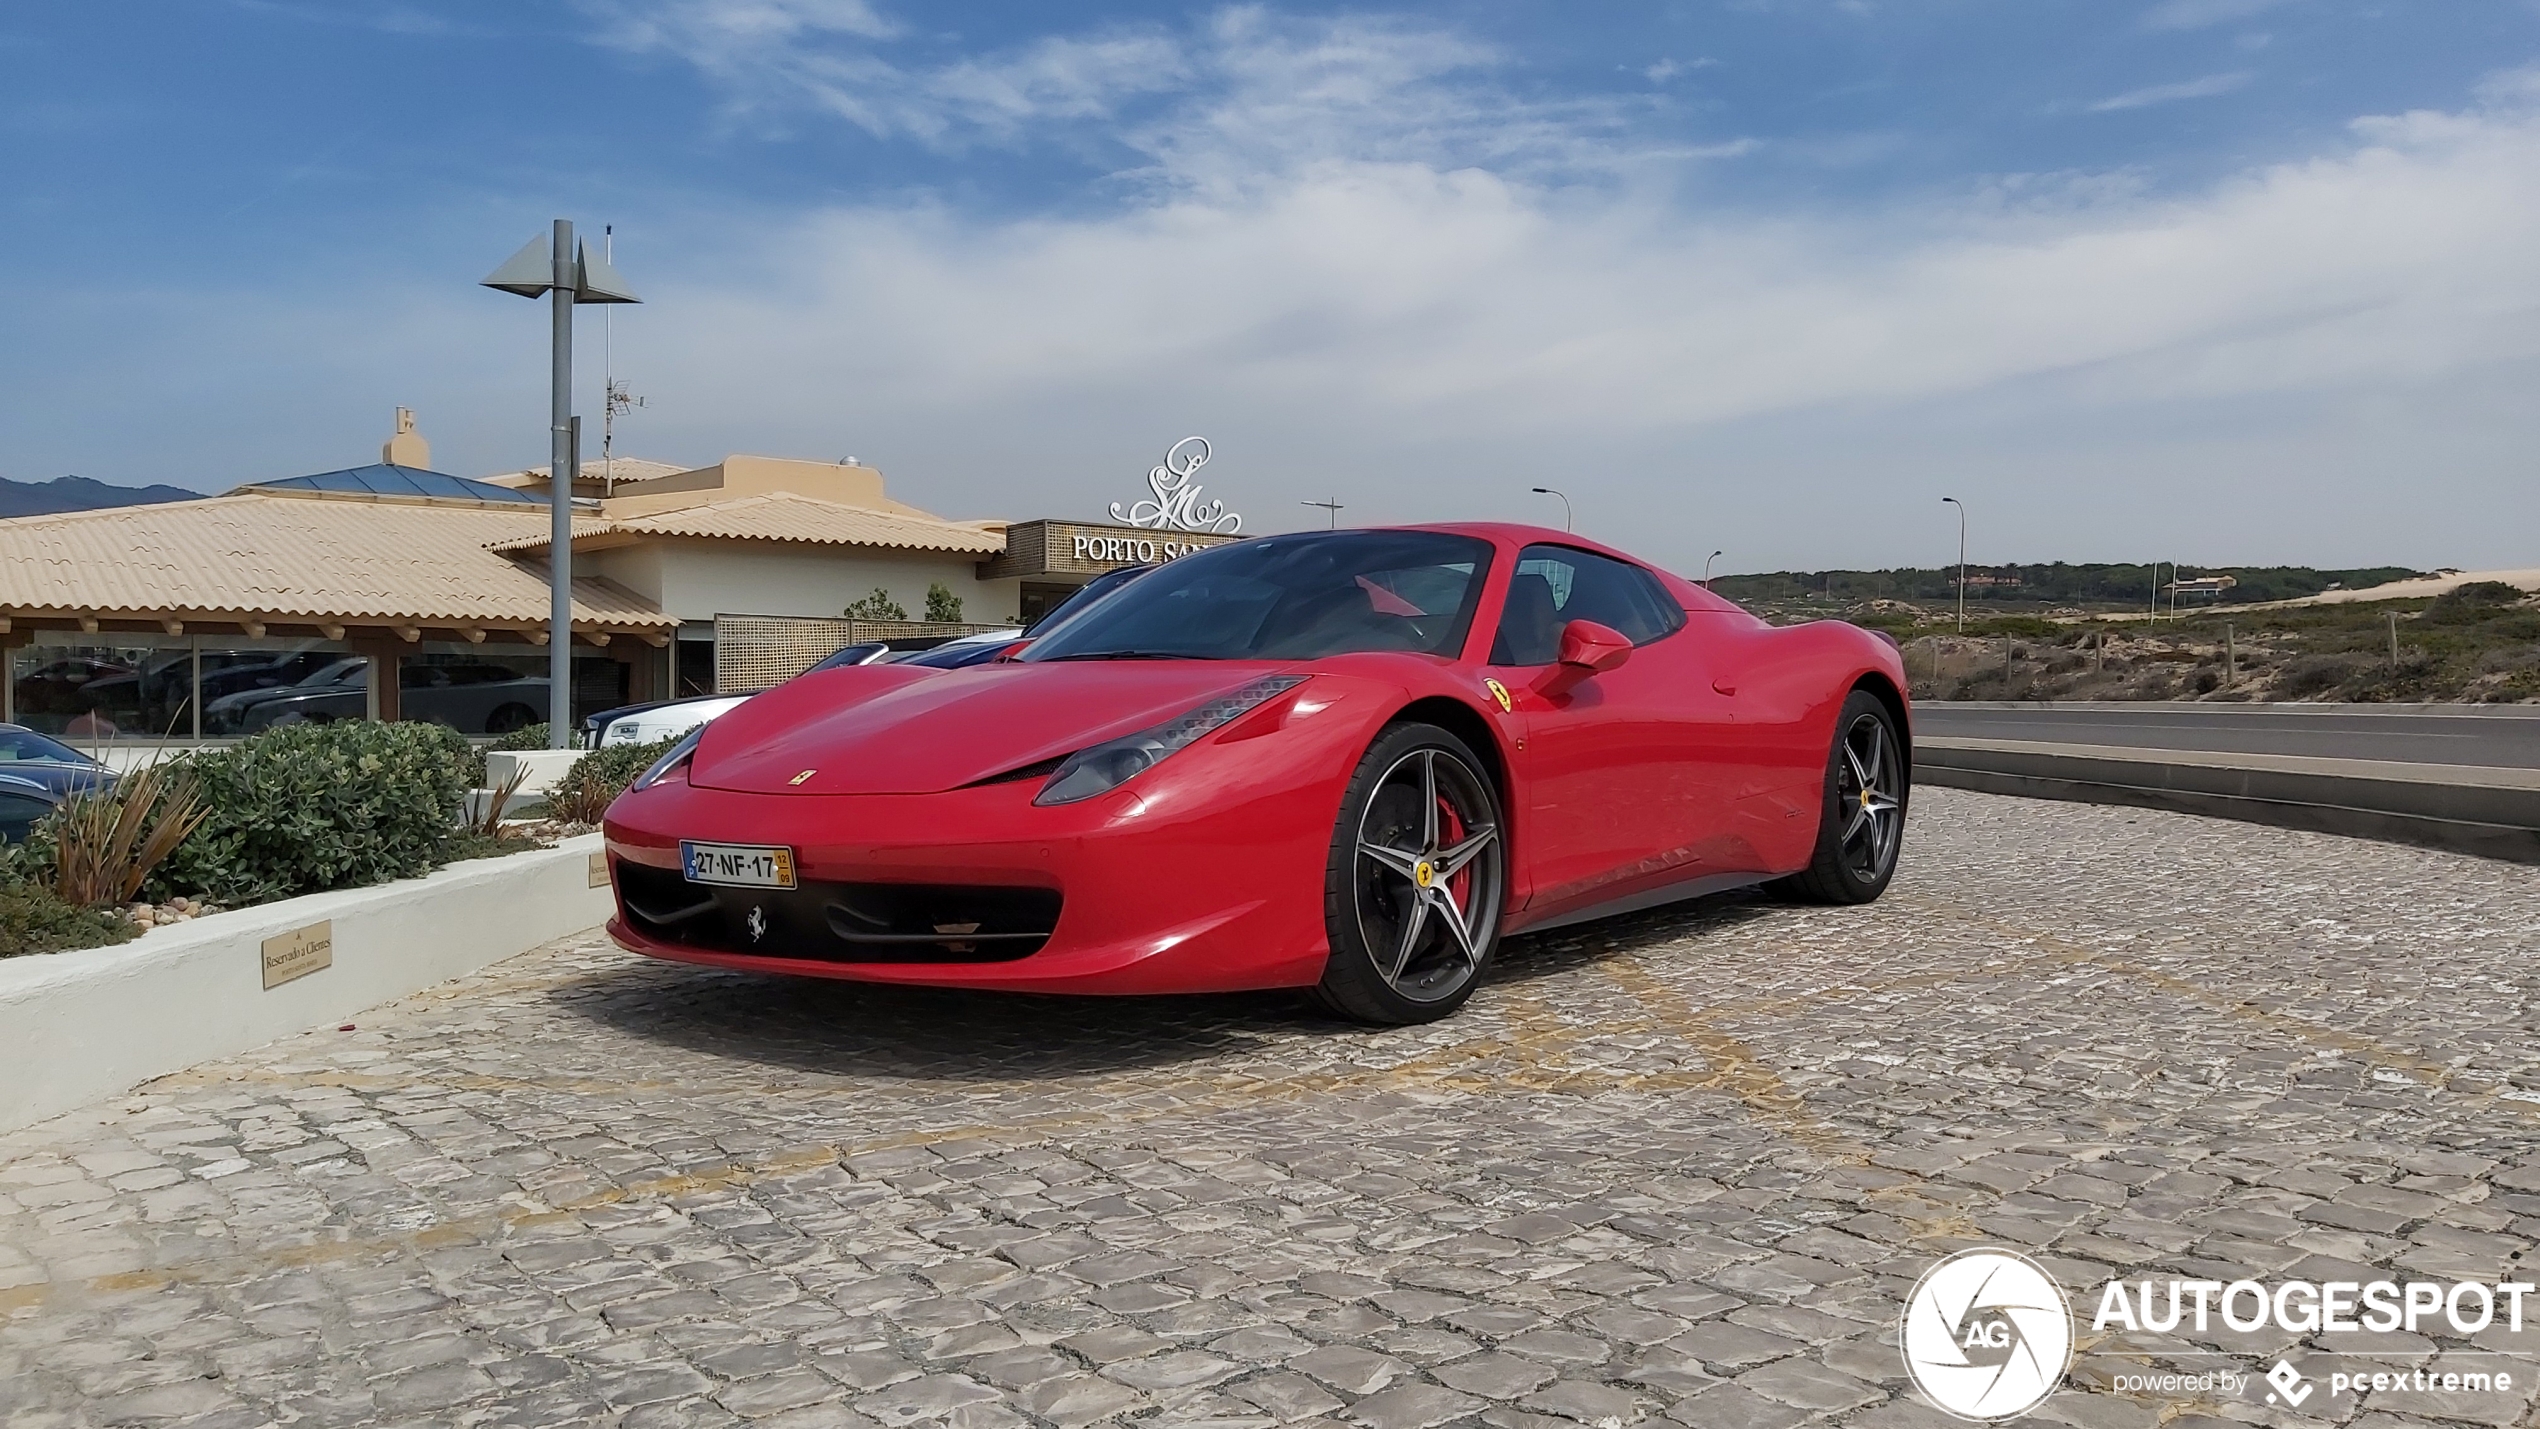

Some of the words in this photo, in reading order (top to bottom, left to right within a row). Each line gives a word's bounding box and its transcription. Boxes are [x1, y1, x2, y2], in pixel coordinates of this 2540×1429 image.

[1073, 536, 1155, 563] PORTO
[777, 854, 788, 864] 12
[688, 867, 695, 877] P
[266, 947, 301, 969] Reservado
[301, 947, 306, 957] a
[306, 938, 331, 955] Clientes
